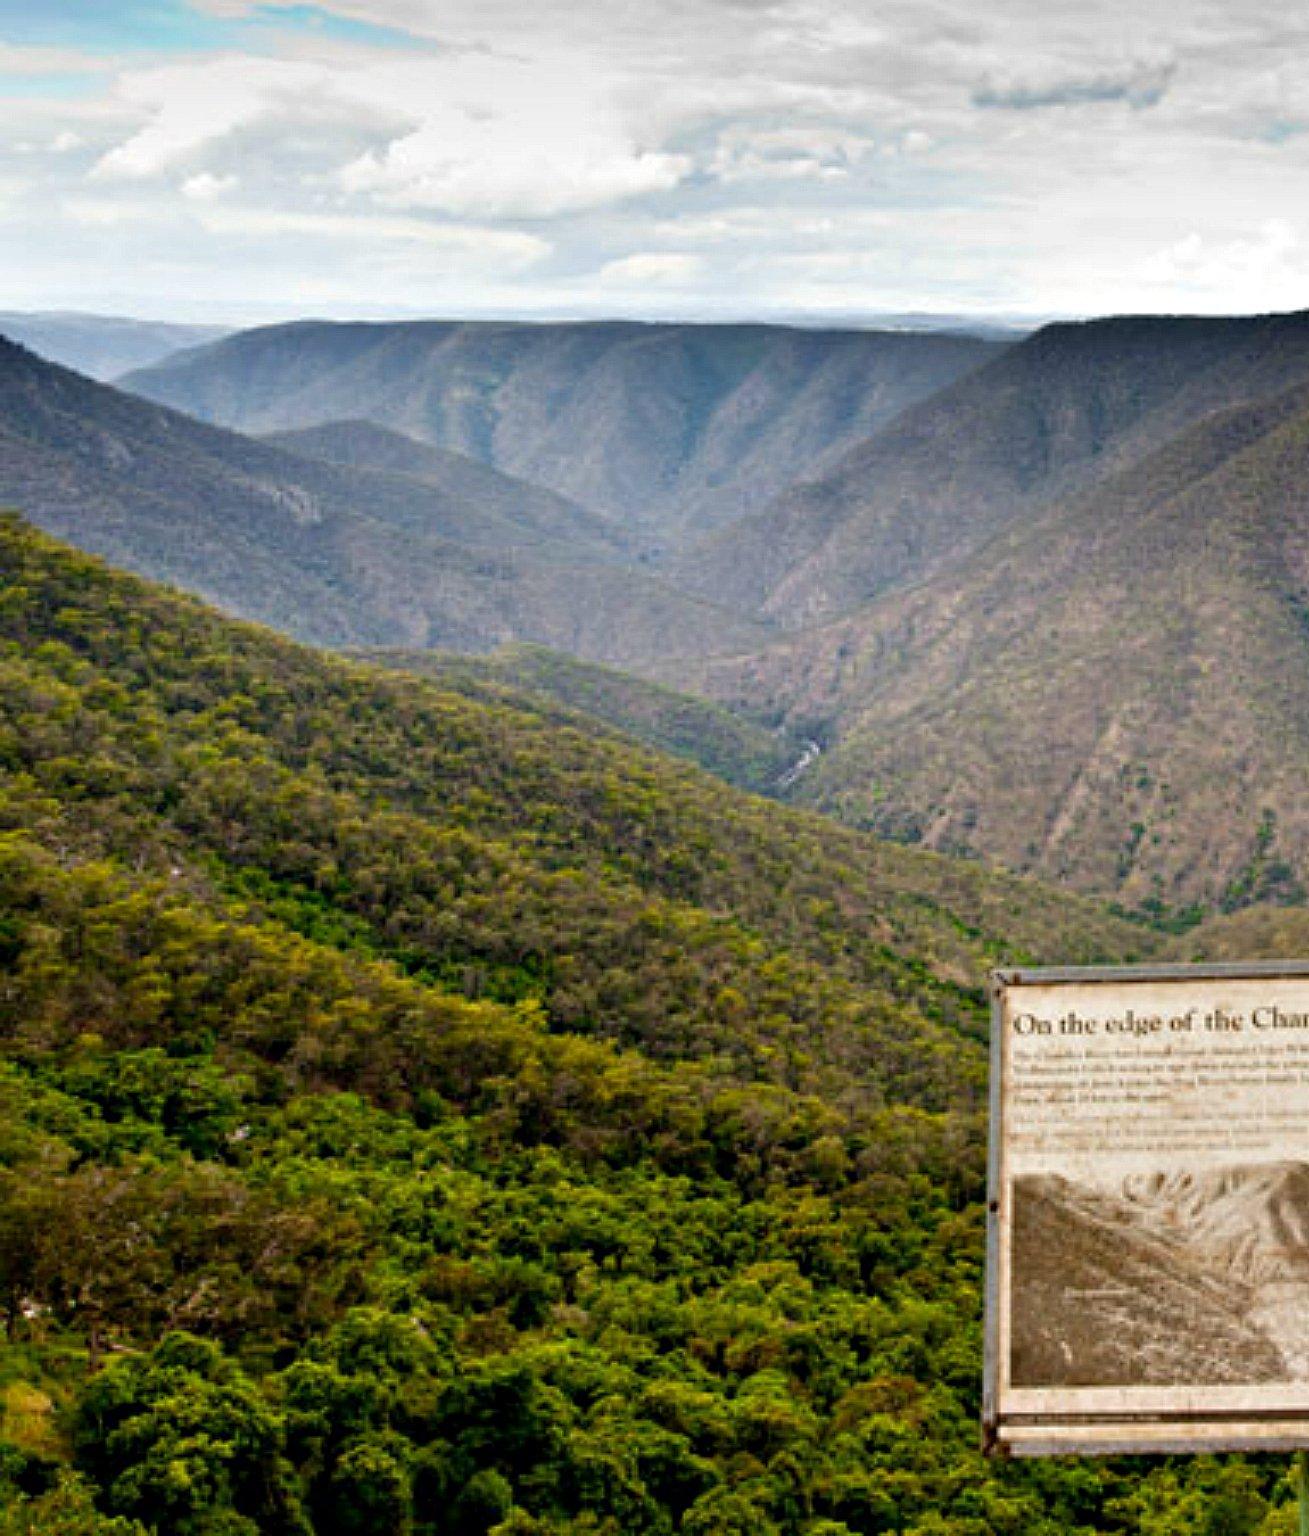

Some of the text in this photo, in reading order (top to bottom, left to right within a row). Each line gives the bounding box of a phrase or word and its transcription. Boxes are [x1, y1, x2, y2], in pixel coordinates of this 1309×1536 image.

[1013, 1013, 1051, 1035] On
[1060, 1012, 1096, 1034] the
[1105, 1010, 1162, 1037] edge
[1170, 1008, 1198, 1032] of
[1205, 1009, 1244, 1031] the
